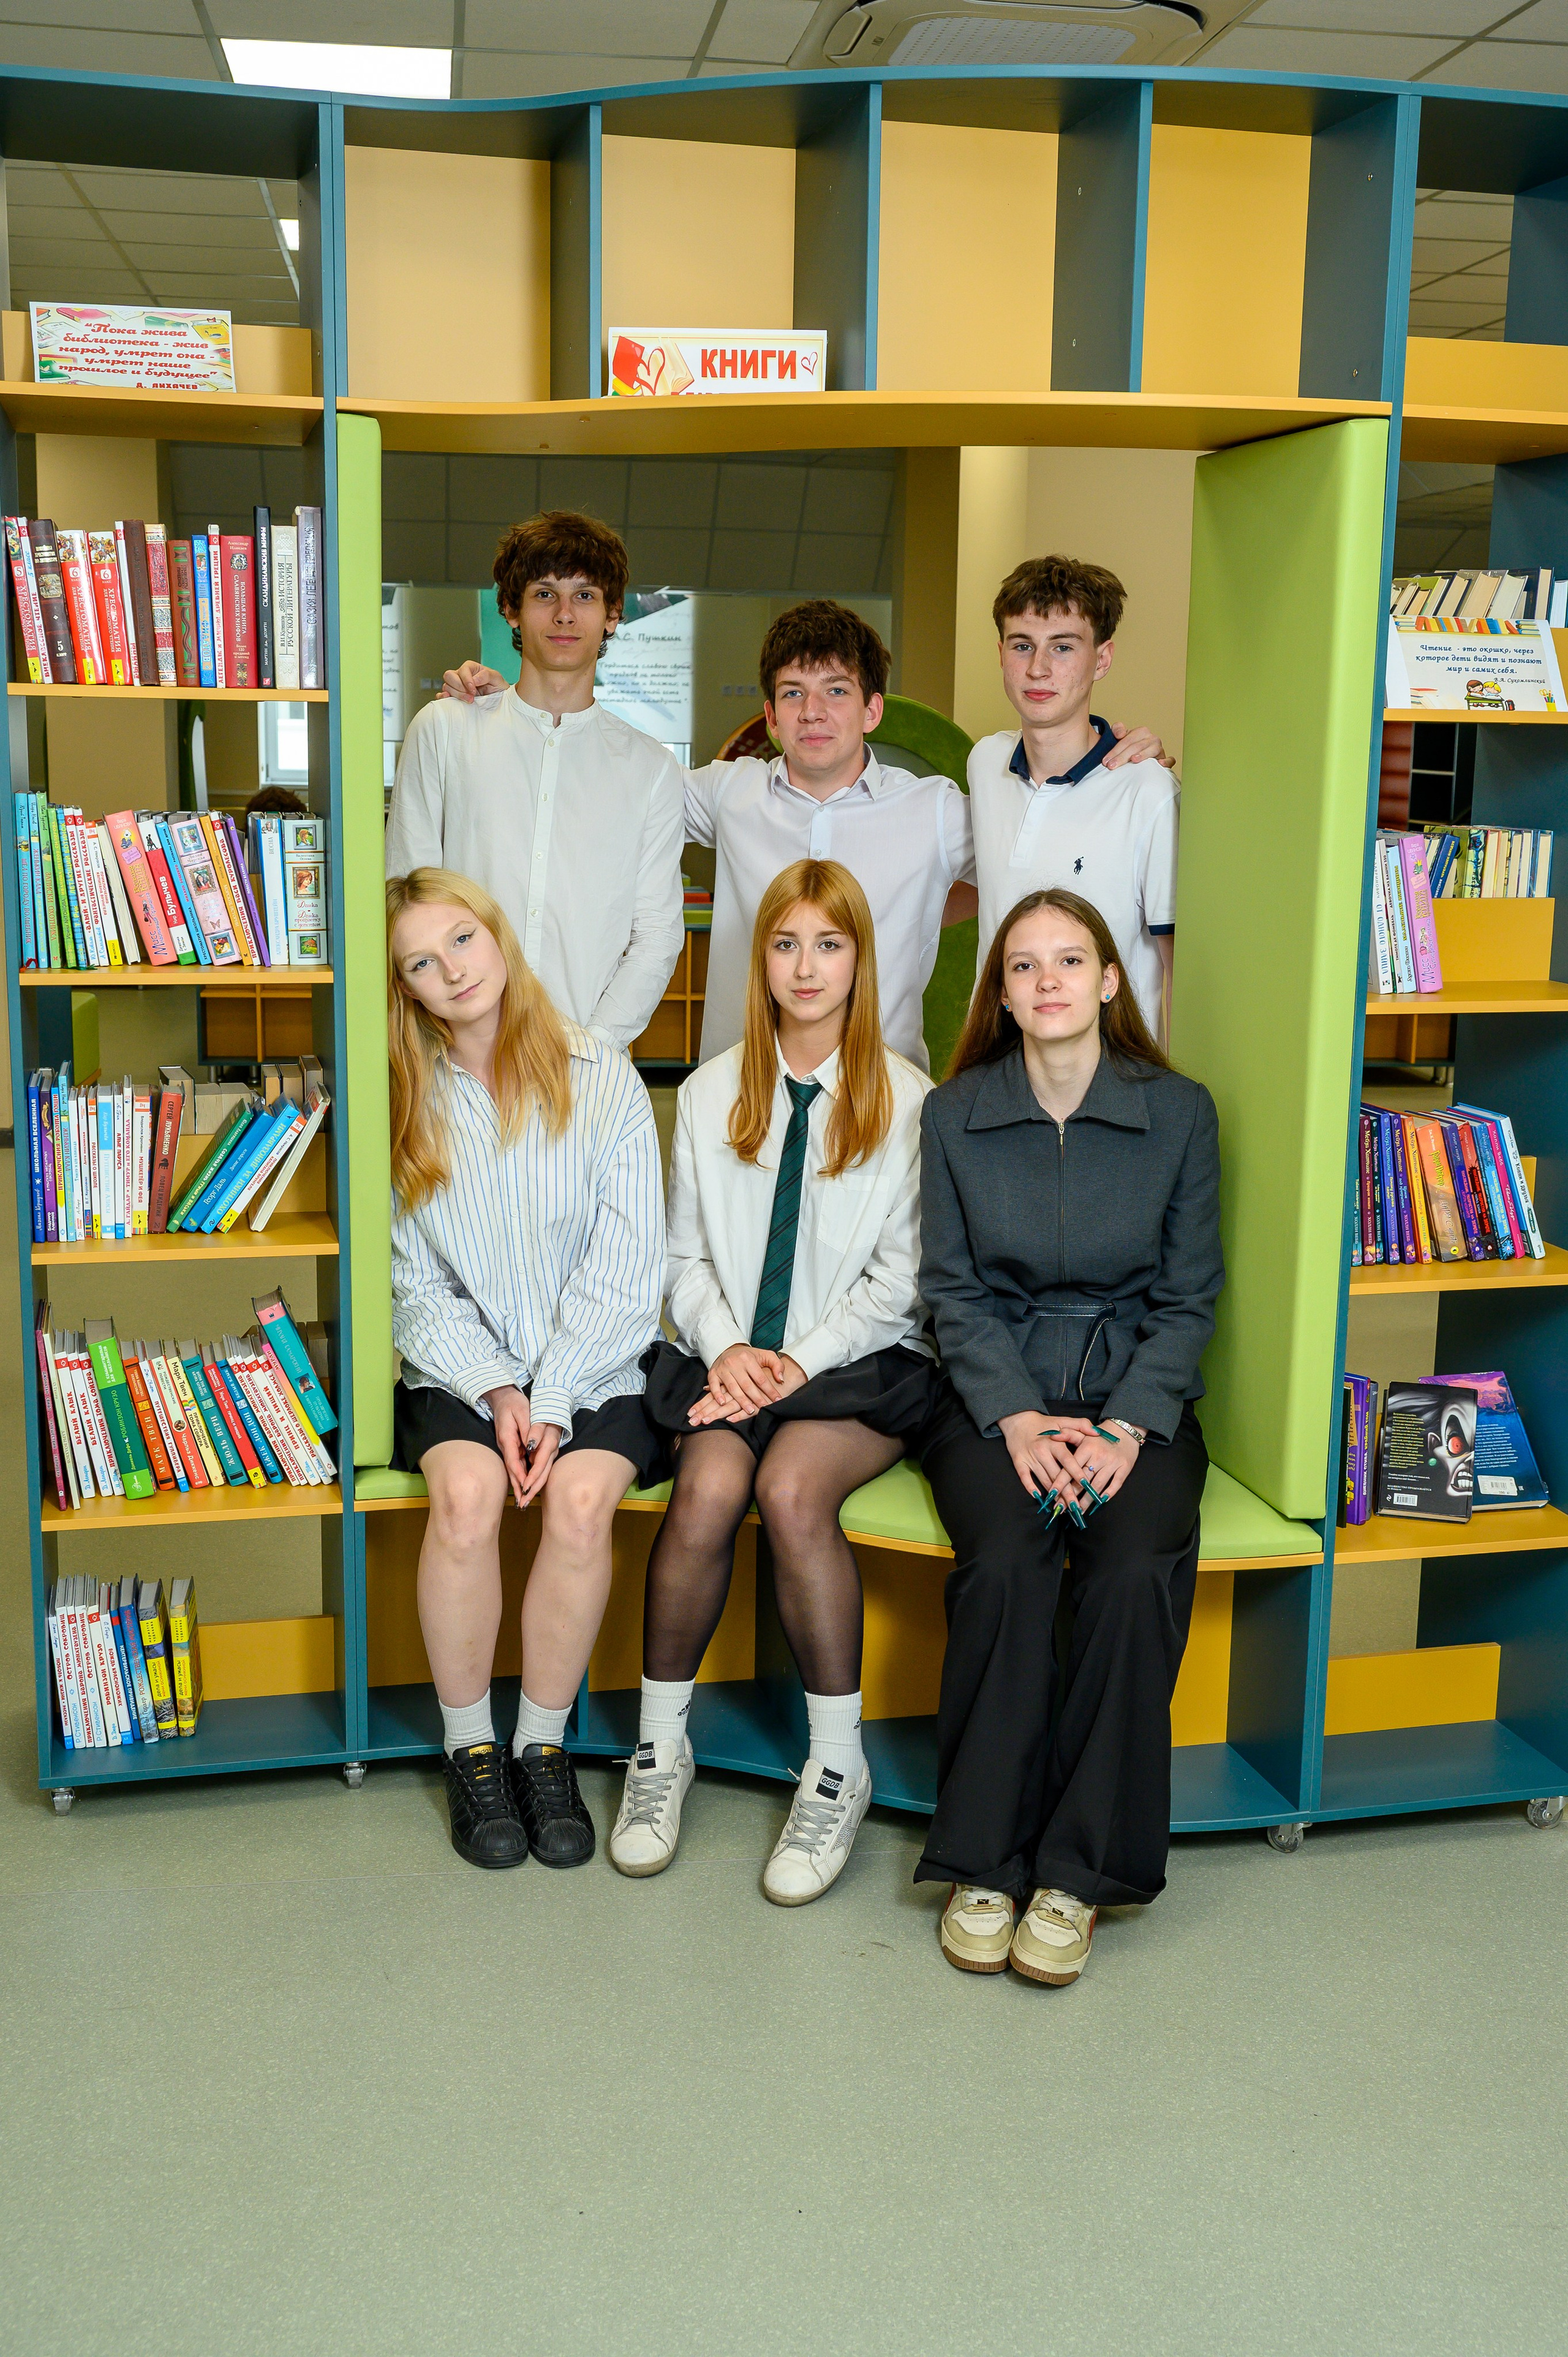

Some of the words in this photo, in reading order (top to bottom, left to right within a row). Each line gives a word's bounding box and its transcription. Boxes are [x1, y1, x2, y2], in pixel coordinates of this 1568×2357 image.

[59, 346, 108, 355] народ,
[114, 349, 173, 361] умрет
[63, 333, 159, 346] библиотека
[59, 365, 127, 374] прошлое
[85, 358, 143, 369] умрет
[701, 349, 796, 379] КНИГИ
[16, 568, 22, 576] 5
[71, 568, 78, 577] 6
[103, 570, 110, 579] 6
[20, 586, 36, 651] ХРЕСТОМАТИЯ
[31, 592, 43, 621] ЧТЕНИЕ
[76, 586, 91, 651] ХРЕСТОМАТИЯ
[108, 588, 122, 653] ХРЕСТОМАТИЯ
[201, 620, 211, 662] ФИЛАТОВ
[285, 614, 294, 647] РУССКОЙ
[35, 624, 50, 677] ВНЕКЛАССНОЕ
[58, 641, 63, 651] 5
[61, 823, 70, 856] БОТИНОК
[80, 829, 90, 866] РАССКАЗЫ
[66, 858, 77, 894] ЛЕТАЮЩИЙ
[175, 864, 184, 884] ЗОЩЕНКО
[220, 838, 236, 886] КУРОЛЕСОВА
[86, 869, 99, 925] ФАНТАСТИЧЕСКИЕ
[99, 871, 109, 904] ПРИКЛЮЧЕНИЯ
[159, 875, 176, 916] Булычев
[233, 886, 241, 904] ВАСИ
[188, 907, 200, 932] ШКОЛЬНИКА
[224, 884, 233, 907] МОРСКИЕ
[231, 905, 239, 927] ИСТОРИИ
[1376, 904, 1383, 913] ОТ
[238, 907, 257, 959] ПРИКЛЮЧЕНИЯ
[1377, 916, 1386, 945] ОДНОГО
[1398, 902, 1407, 941] МАЛЕНЬКИЕ
[153, 930, 167, 956] Мисс
[194, 933, 208, 960] ХРЕСТОМАТИЯ
[1422, 958, 1436, 984] Мисс
[162, 1120, 172, 1155] ЛУКЬЯНЕНКО
[55, 1143, 64, 1190] ПРИКЛЮЧЕНИЯ
[214, 1148, 227, 1167] СОБАЧЬЯ
[217, 1177, 245, 1215] ОХОТНИКИ
[243, 1170, 252, 1180] ЗА
[251, 1123, 286, 1171] ДИНОЗАВРАМИ
[256, 1158, 277, 1185] ПРИКЛЮЧЕНИЯ
[1428, 1150, 1441, 1168] Гарри
[203, 1167, 214, 1182] ЖИЗНЬ
[203, 1190, 216, 1205] Георг
[217, 1178, 227, 1192] Даль
[162, 1371, 176, 1404] РОЖДЕСТВЕНСКИЕ
[172, 1361, 182, 1379] Марк
[179, 1380, 187, 1397] Твен
[67, 1391, 76, 1414] КЛЫК
[79, 1392, 90, 1416] КЛЫК
[111, 1390, 121, 1409] КРУЗО
[72, 1418, 82, 1445] БЕЛЫЙ
[85, 1419, 97, 1446] БЕЛЫЙ
[116, 1409, 127, 1439] РОБИНЗОН
[145, 1416, 157, 1442] ТВЕН
[194, 1412, 209, 1449] ПРИКЛЮЧЕНИЯ
[194, 1428, 203, 1447] СОЙЕРА
[210, 1415, 224, 1437] ВЕРН
[243, 1411, 262, 1444] ЛОНДОН
[153, 1447, 166, 1474] МАРК
[181, 1432, 190, 1455] Чарльз
[187, 1455, 199, 1480] Диккенс
[221, 1439, 235, 1466] ЖЮЛЬ
[258, 1444, 274, 1468] ДЖЕК
[59, 1613, 69, 1650] СОКРОВИЩ
[79, 1613, 89, 1649] СОКРОВИЩ
[72, 1626, 82, 1668] МЮНХГАУЗЕНА
[97, 1643, 105, 1666] КРУЗО
[64, 1653, 73, 1680] ОСТРОВ
[100, 1668, 111, 1706] РОБИНЗОН
[112, 1668, 123, 1706] КРАСНОКОЖИХ
[119, 1645, 132, 1688] КЕНТЕРВИЛЬСКОЕ
[129, 1688, 138, 1720] ПРИВИДЕНИЕ
[81, 1698, 93, 1743] ПРИКЛЮЧЕНИЯ
[822, 1778, 839, 1789] GGDB
